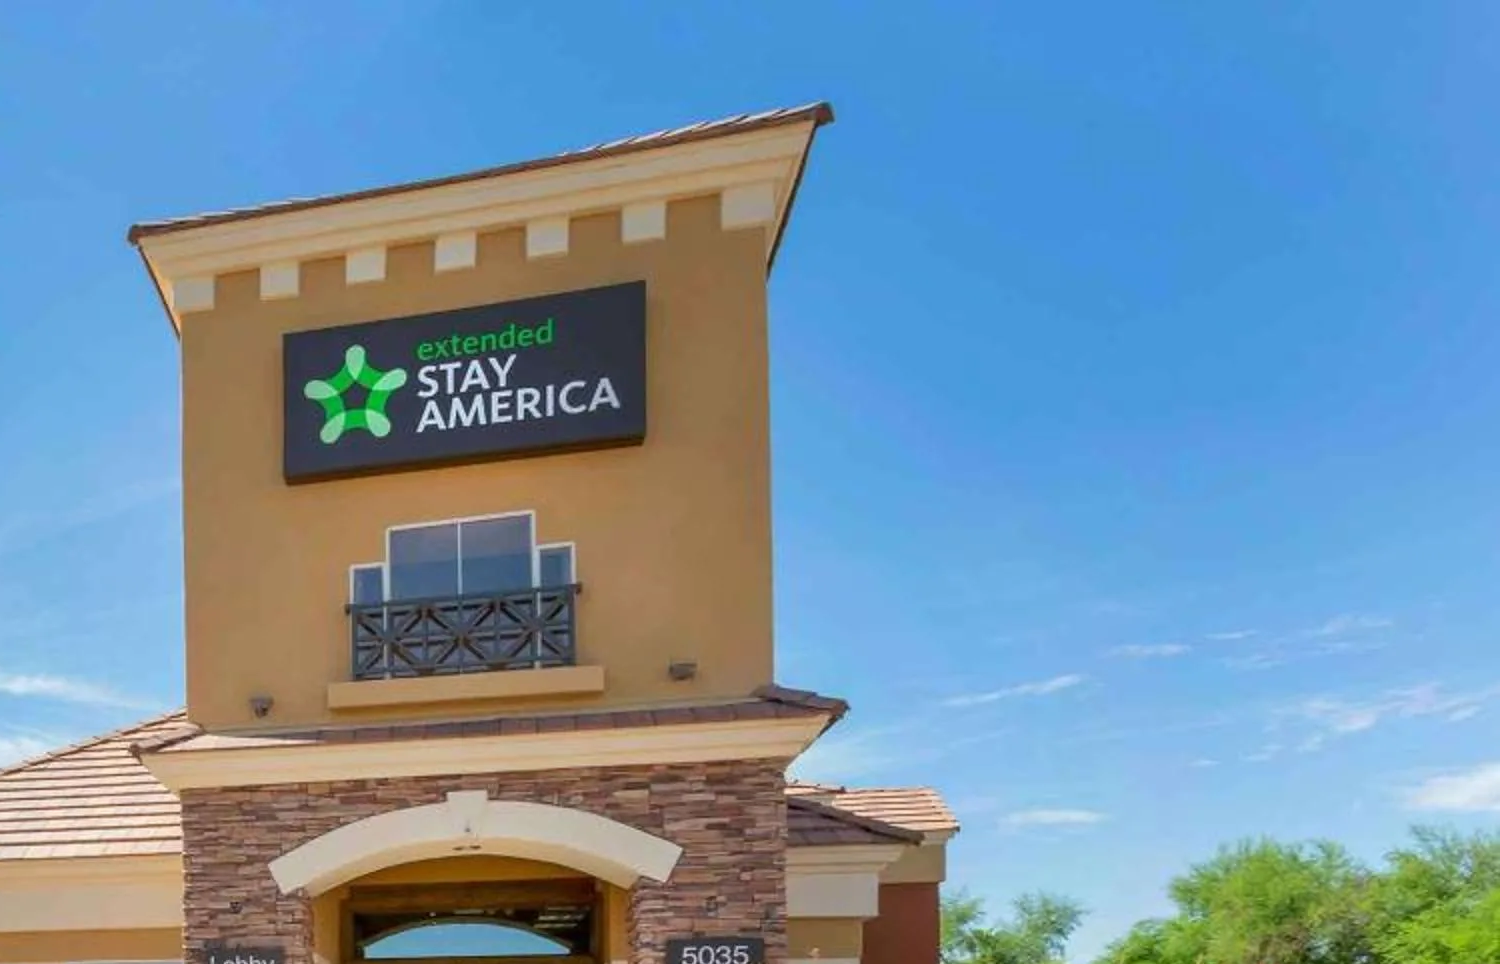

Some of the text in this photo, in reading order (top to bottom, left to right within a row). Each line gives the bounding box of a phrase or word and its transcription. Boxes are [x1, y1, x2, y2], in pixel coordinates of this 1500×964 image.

[416, 318, 555, 361] extended
[416, 353, 517, 398] STAY
[415, 377, 621, 433] AMERICA
